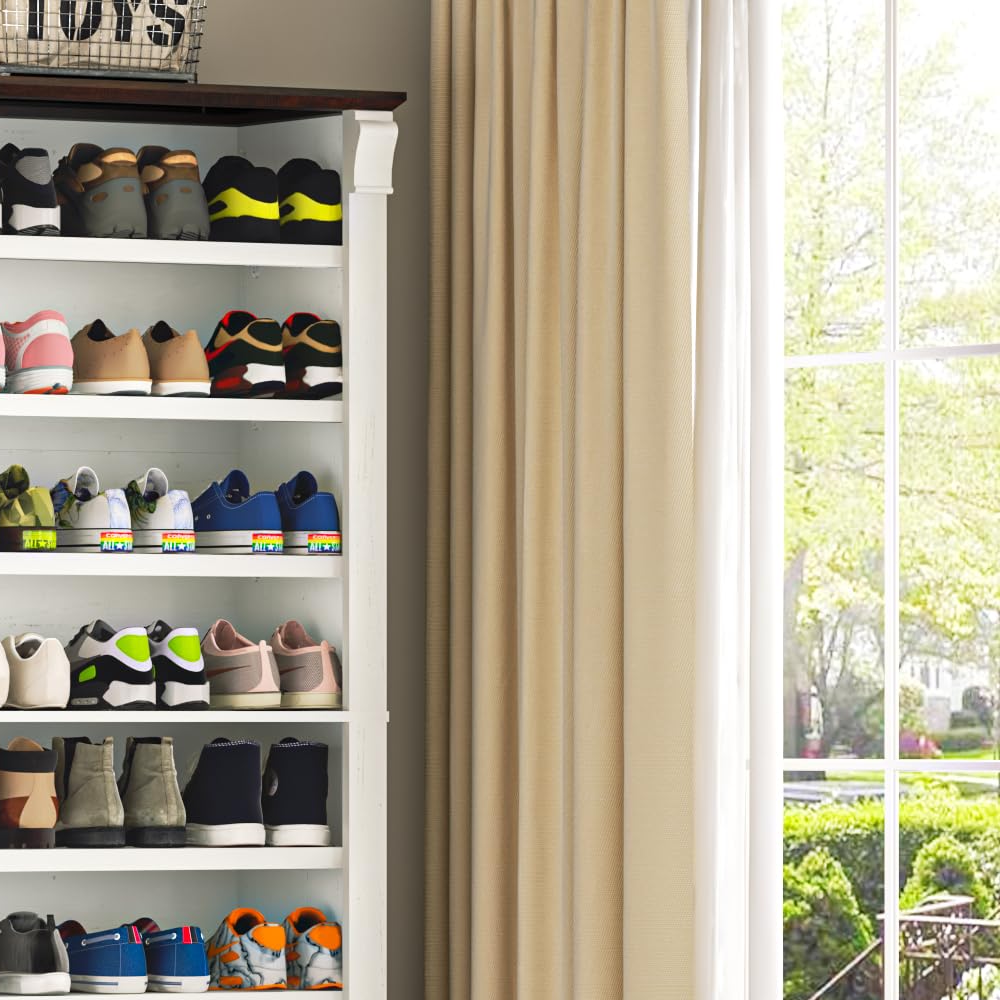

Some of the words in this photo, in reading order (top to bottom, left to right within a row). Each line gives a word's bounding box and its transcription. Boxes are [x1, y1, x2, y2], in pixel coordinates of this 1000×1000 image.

[102, 541, 115, 550] ALL
[163, 542, 177, 551] ALL
[254, 542, 266, 551] ALL
[309, 542, 322, 551] ALL
